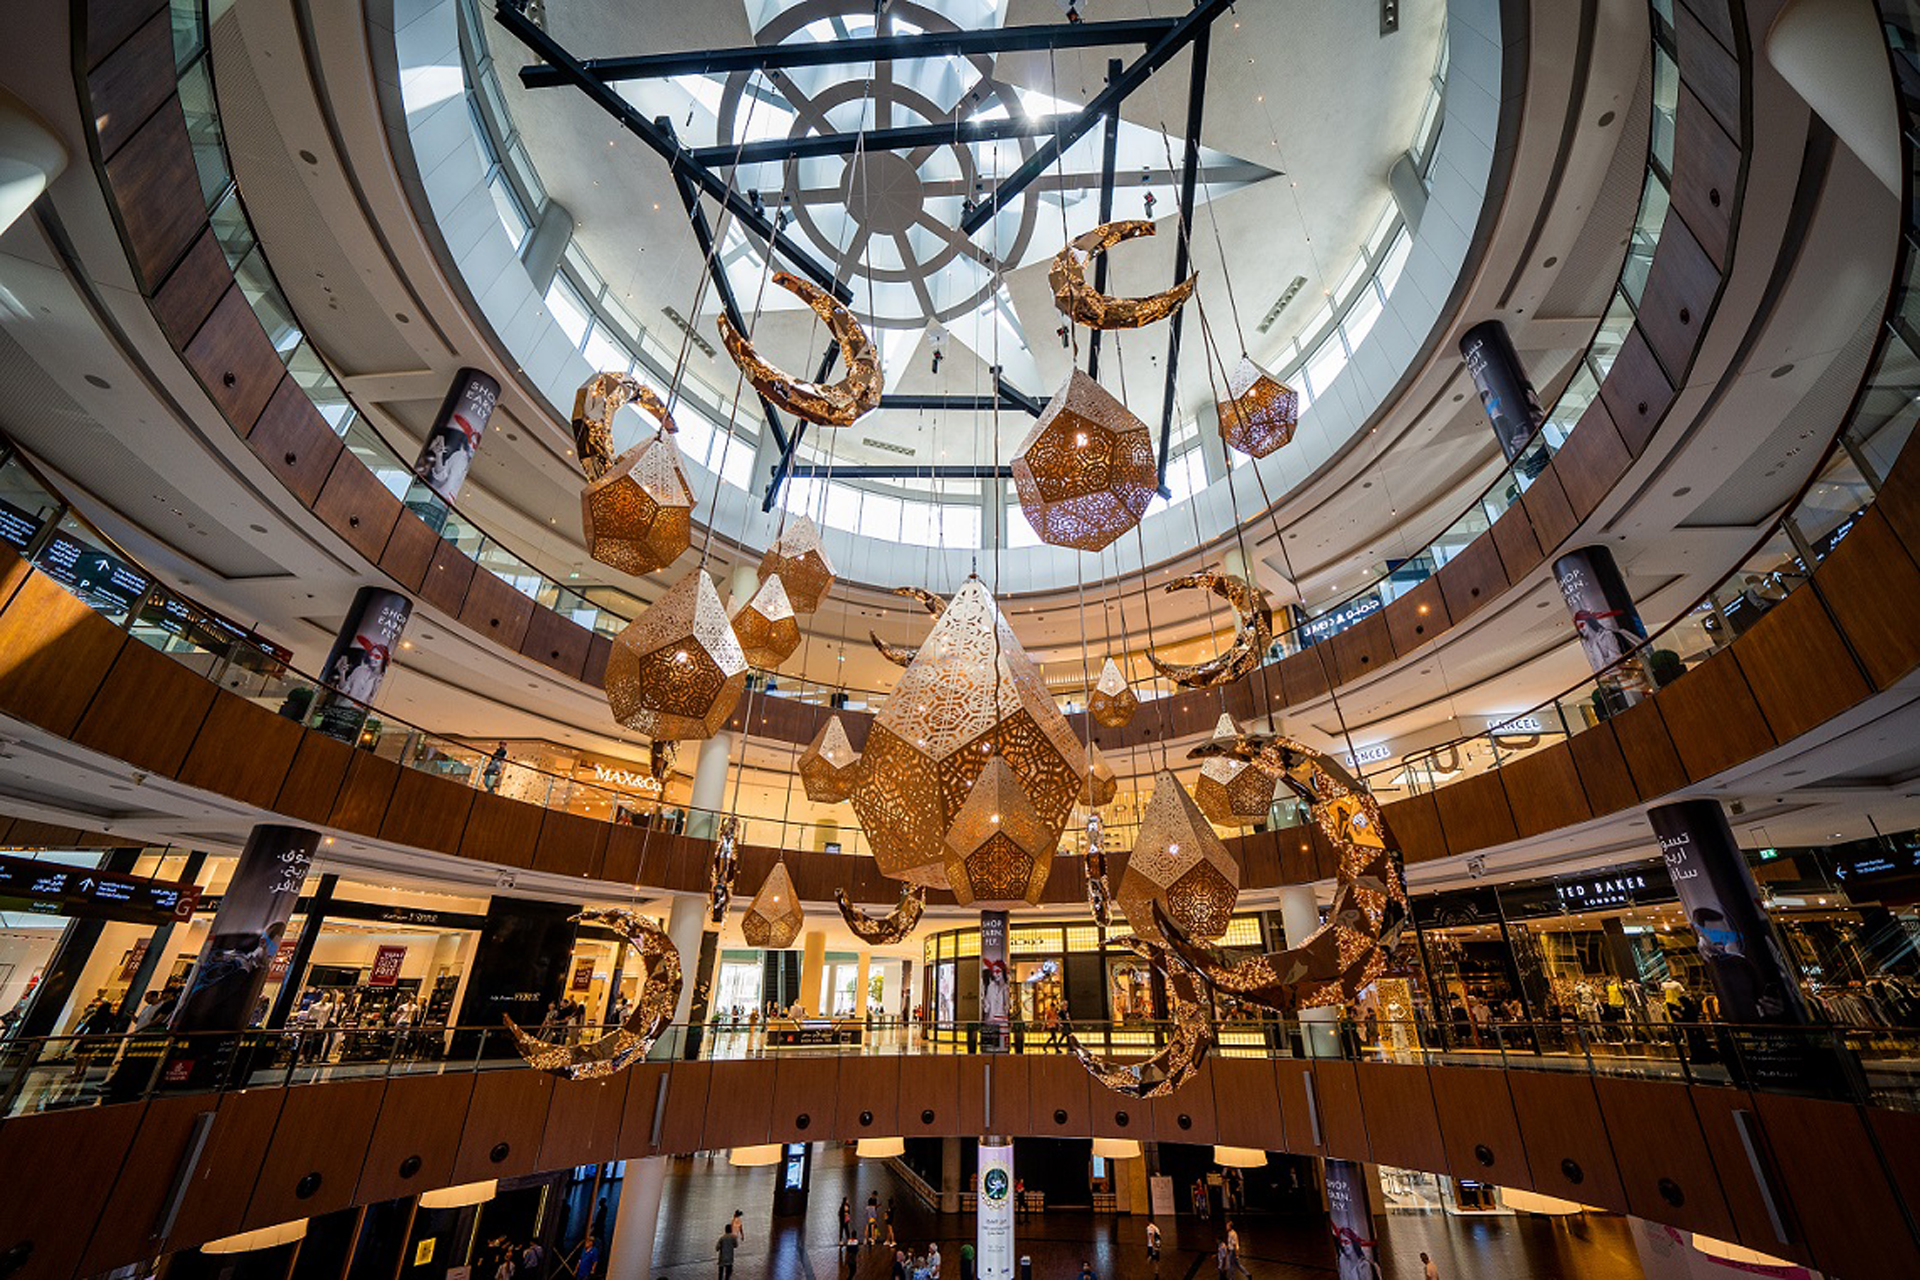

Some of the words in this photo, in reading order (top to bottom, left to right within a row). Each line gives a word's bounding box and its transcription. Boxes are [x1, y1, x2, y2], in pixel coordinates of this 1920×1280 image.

[1560, 568, 1585, 588] HOP.
[1557, 886, 1585, 899] TED
[1594, 876, 1646, 894] BAKER
[175, 898, 193, 916] G
[1584, 895, 1625, 906] LONDON
